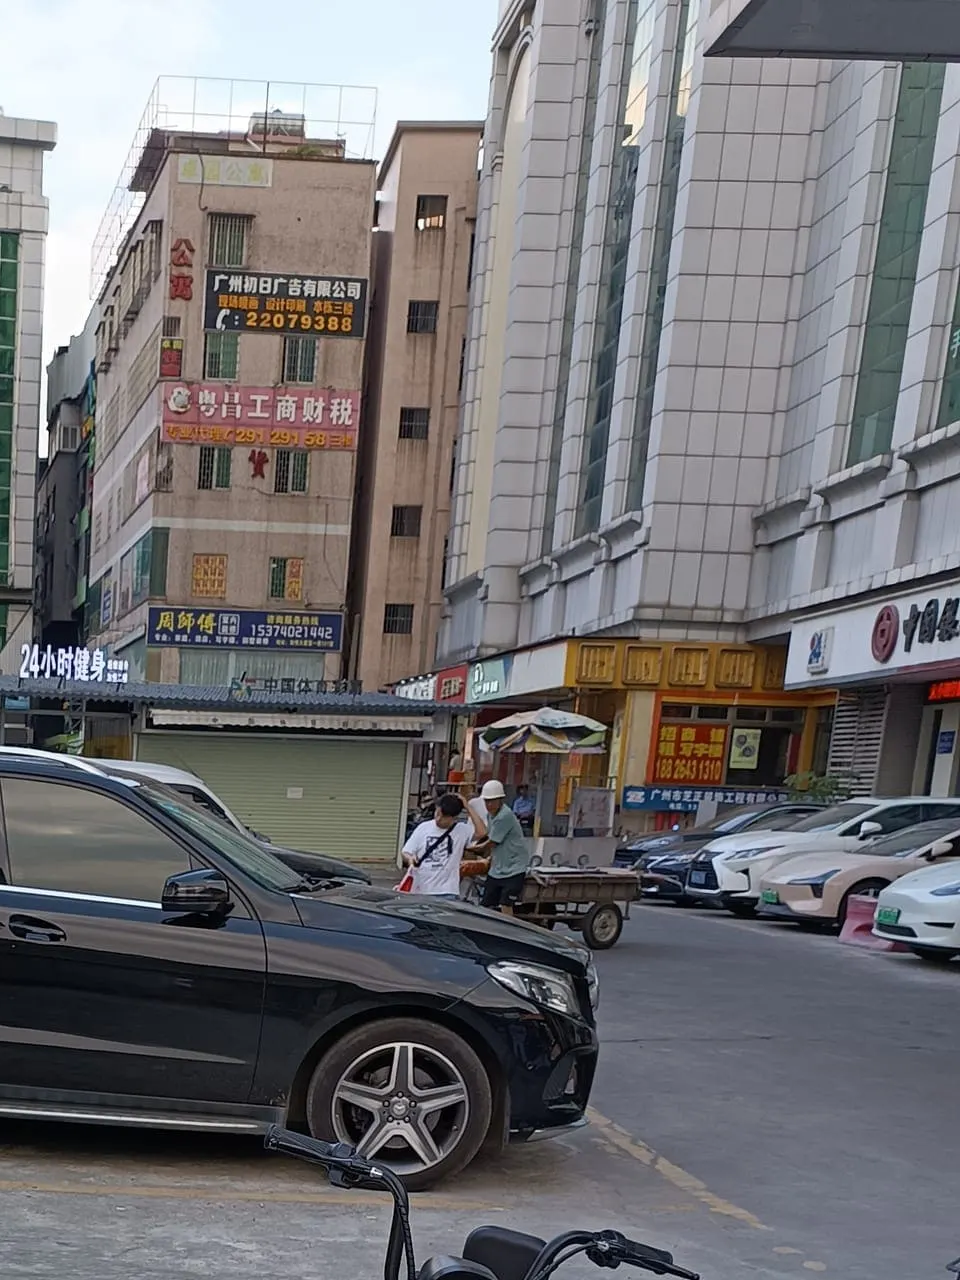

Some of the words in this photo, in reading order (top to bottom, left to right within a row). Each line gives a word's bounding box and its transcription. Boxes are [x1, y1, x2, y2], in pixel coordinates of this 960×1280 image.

[171, 238, 196, 301] 公寓
[213, 274, 361, 299] 广州初日广告有限公司
[266, 299, 307, 313] 设计印刷
[198, 388, 353, 426] 粤昌工商财税
[167, 426, 222, 442] 专业代理
[235, 429, 264, 443] 291
[270, 431, 299, 445] 291
[304, 433, 326, 446] 58
[250, 624, 334, 639] 15374021442
[20, 643, 106, 683] 24小时健身
[699, 759, 722, 780] 1310
